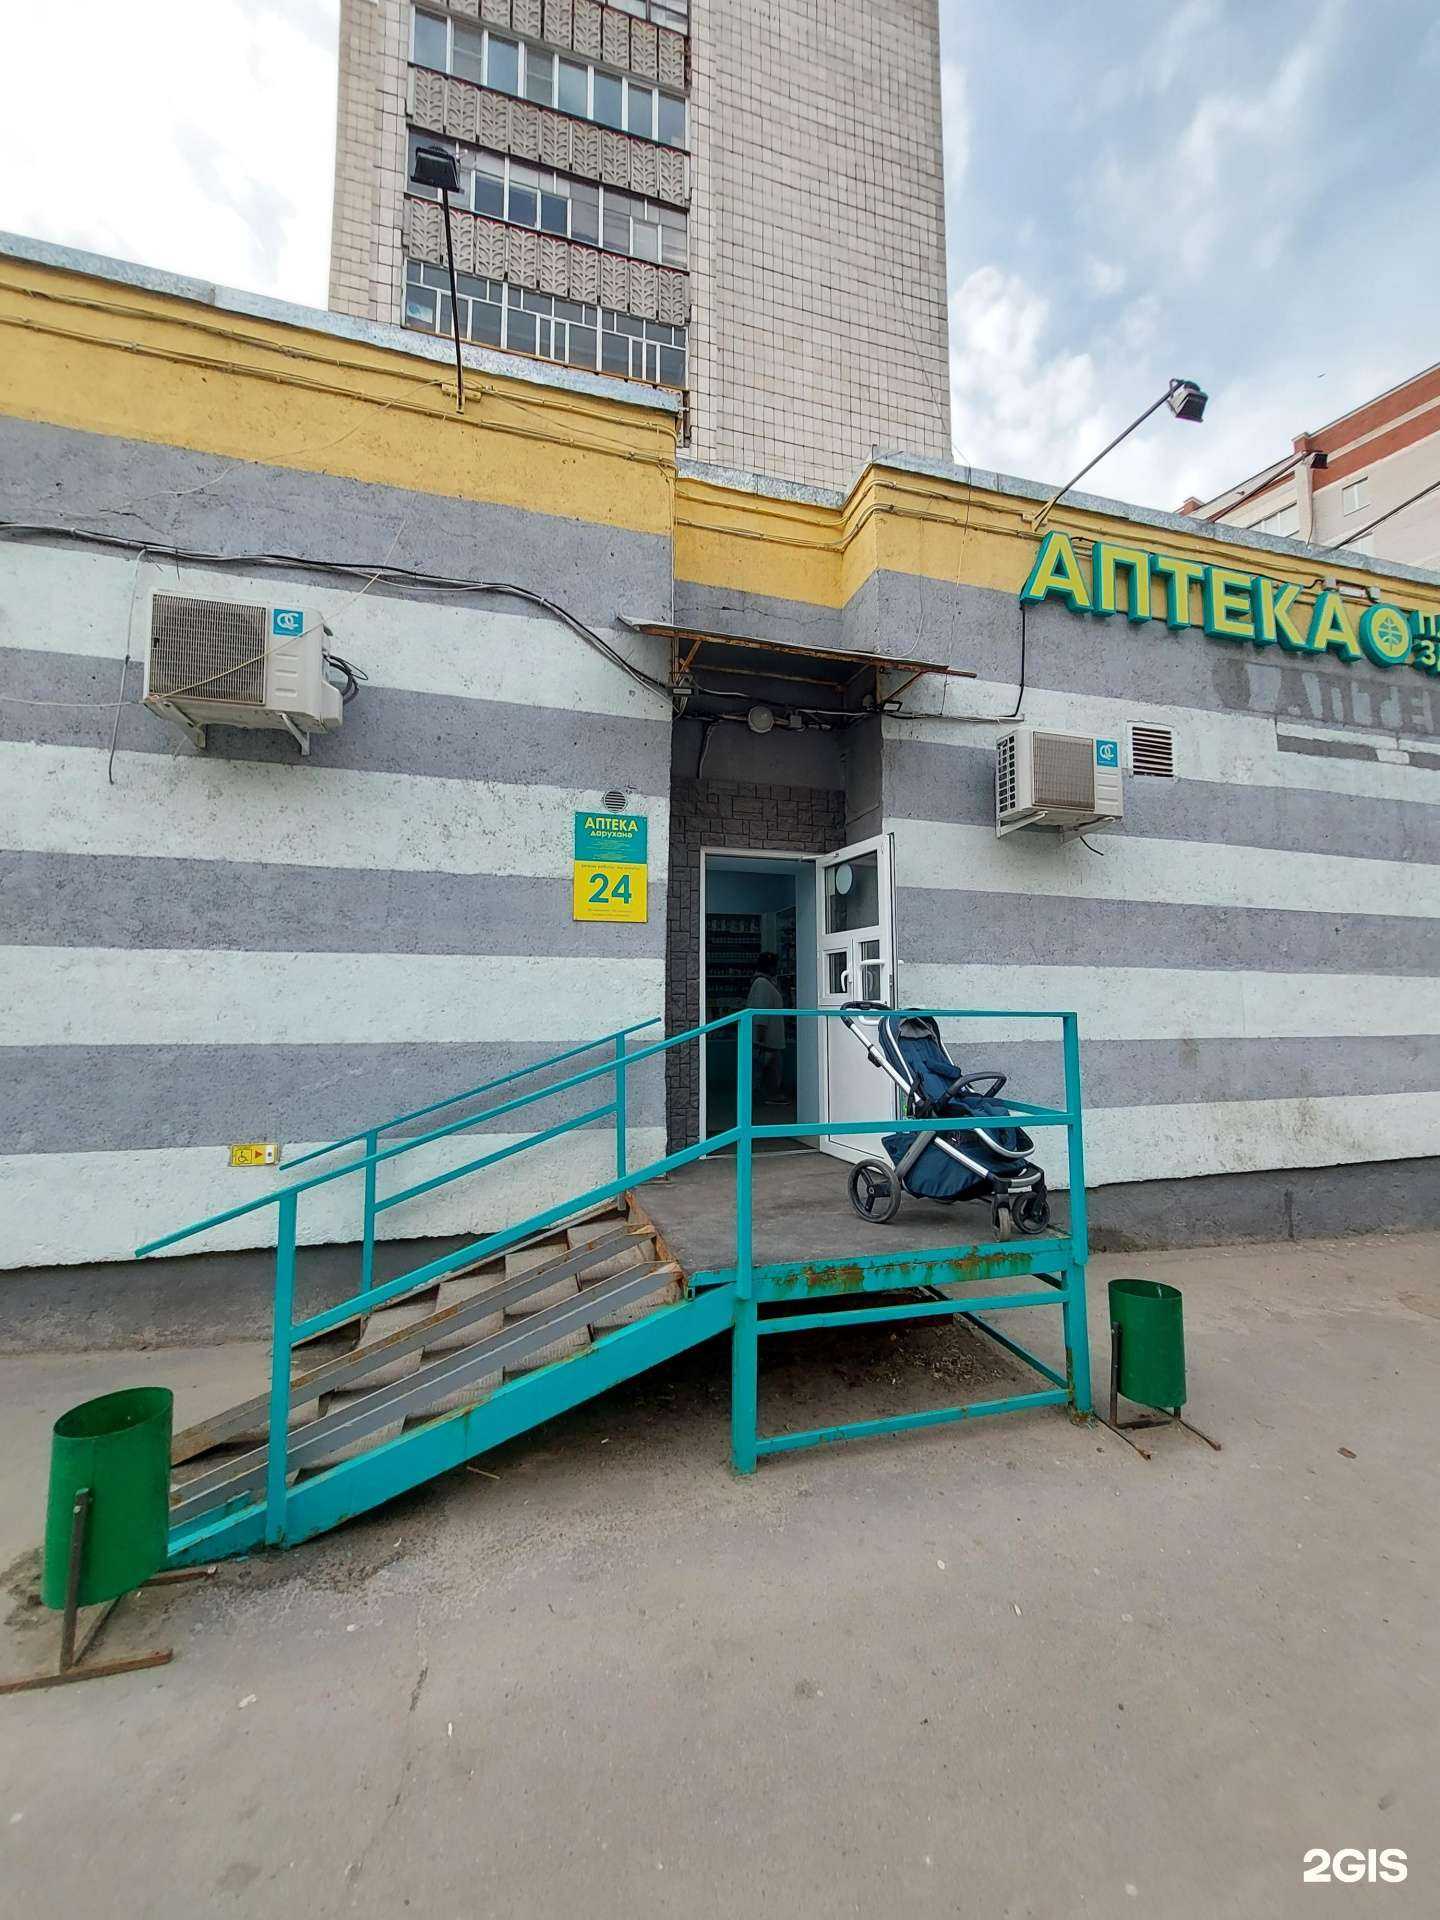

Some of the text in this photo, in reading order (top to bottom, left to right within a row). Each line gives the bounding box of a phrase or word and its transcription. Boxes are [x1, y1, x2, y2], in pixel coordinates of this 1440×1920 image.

[1021, 531, 1363, 662] АПТЕКА
[584, 817, 639, 832] АПТЕКА
[588, 873, 632, 904] 24
